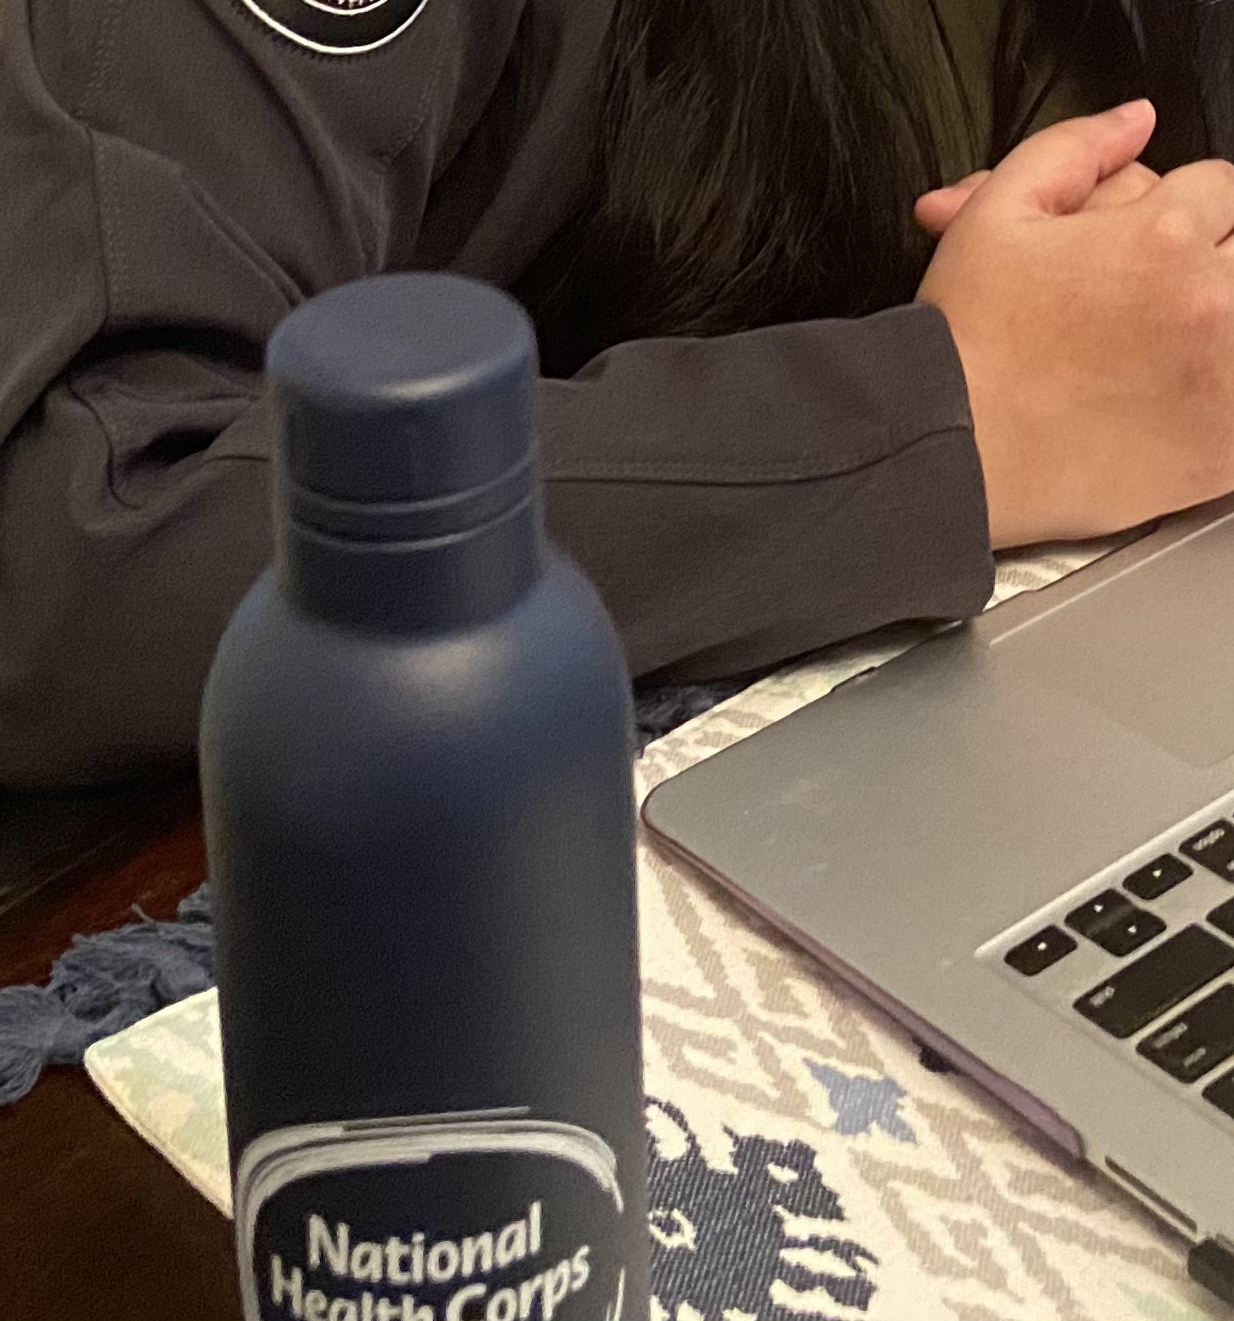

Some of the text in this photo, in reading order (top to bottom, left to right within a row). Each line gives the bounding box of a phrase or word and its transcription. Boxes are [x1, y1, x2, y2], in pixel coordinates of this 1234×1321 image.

[271, 1244, 590, 1321] Health Corps
[307, 1199, 542, 1285] National
